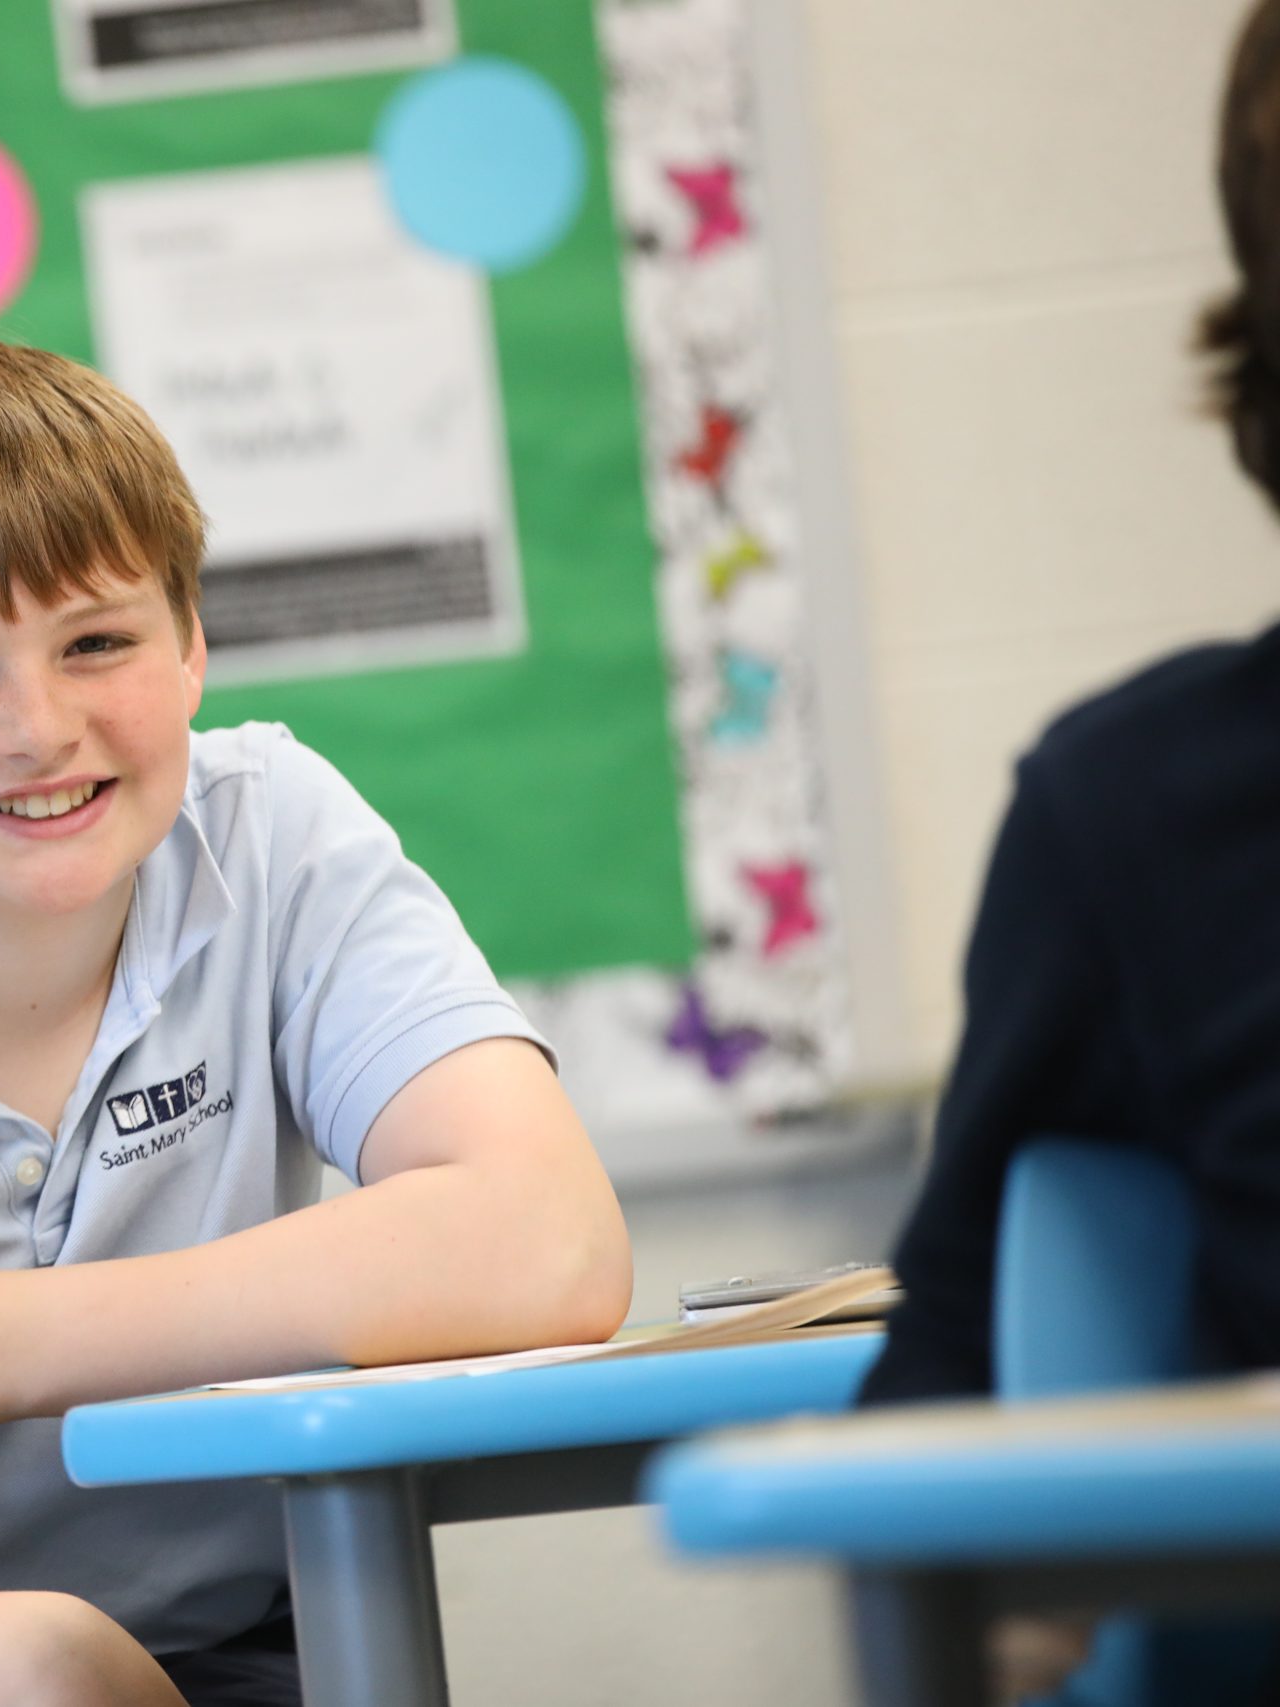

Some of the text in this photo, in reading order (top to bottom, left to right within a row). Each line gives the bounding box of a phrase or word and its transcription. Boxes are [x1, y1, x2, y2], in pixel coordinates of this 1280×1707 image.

[100, 1090, 234, 1170] Saint Mary School
